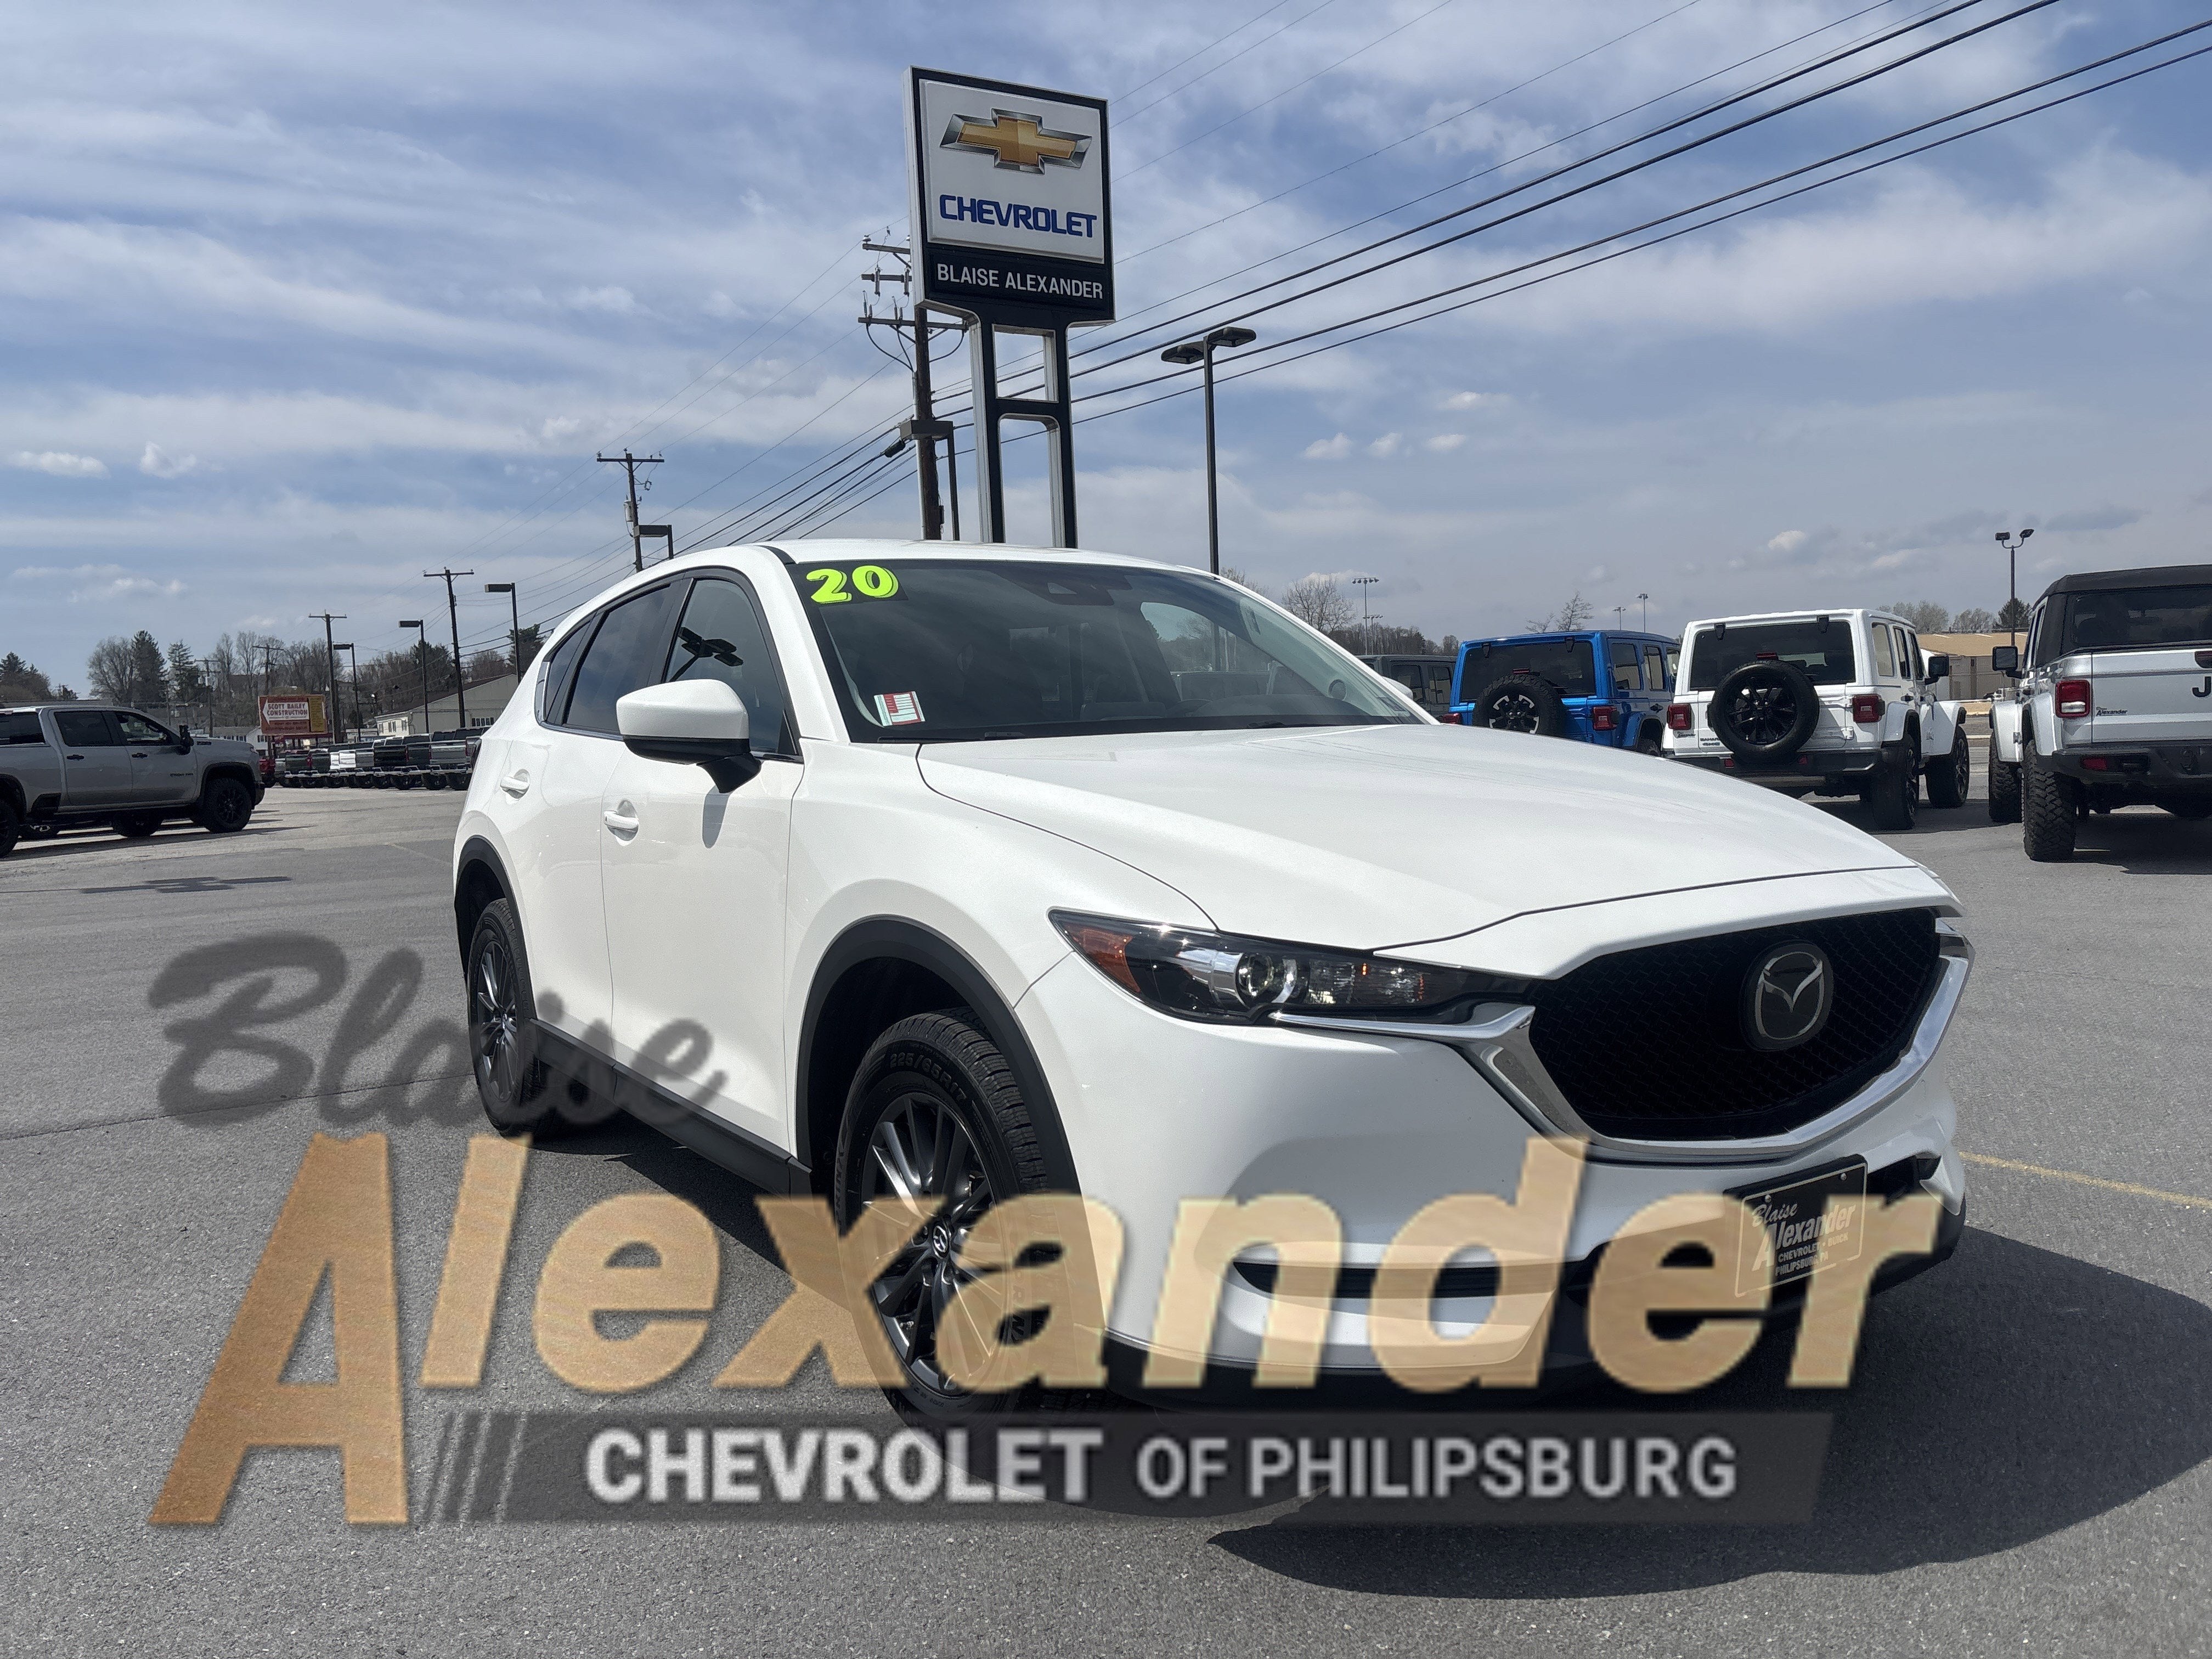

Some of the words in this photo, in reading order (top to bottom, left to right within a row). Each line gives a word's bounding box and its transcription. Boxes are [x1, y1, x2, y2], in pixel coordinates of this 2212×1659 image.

[939, 194, 1097, 238] CHEVROLET
[937, 263, 999, 287] BLAISE
[1005, 272, 1103, 300] ALEXANDER
[806, 565, 899, 603] 20
[1752, 1203, 1798, 1227] Blaise
[1752, 1204, 1857, 1272] Alexander
[1778, 1242, 1820, 1262] CHEVROLET
[1828, 1232, 1849, 1247] BUICK
[1820, 1251, 1829, 1262] PA
